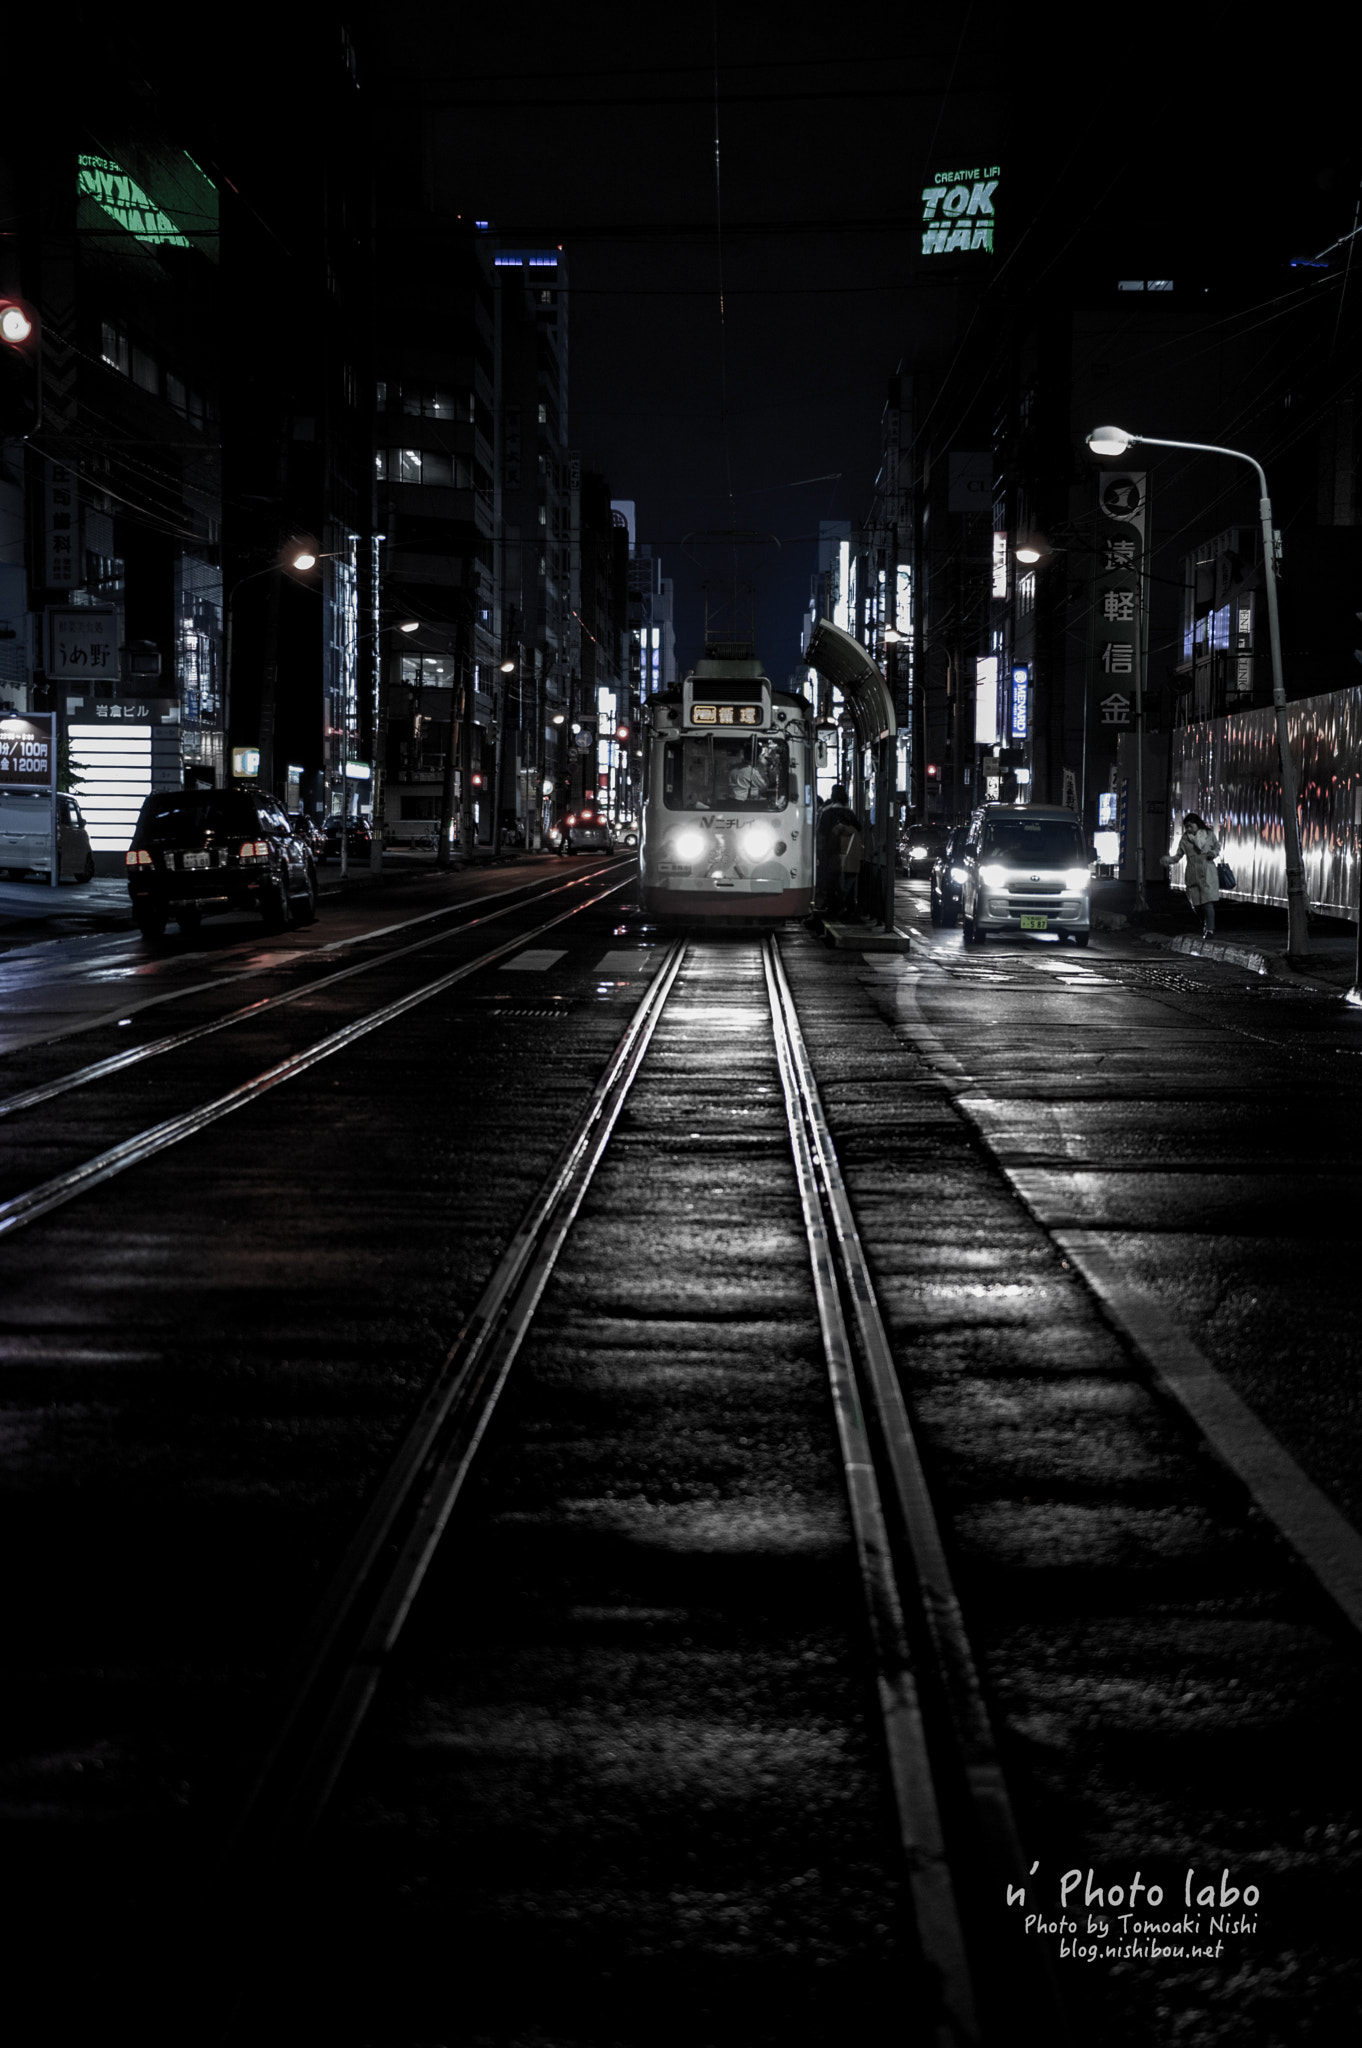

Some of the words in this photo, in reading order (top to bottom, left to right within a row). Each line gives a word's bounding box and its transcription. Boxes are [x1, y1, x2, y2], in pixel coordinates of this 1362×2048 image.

[934, 168, 981, 184] CREATIVE
[921, 180, 999, 219] TOK
[1100, 539, 1136, 725] 遠軽信金
[60, 642, 111, 668] うめ野
[95, 704, 150, 718] 岩倉ビル
[1017, 684, 1027, 731] MENARD
[13, 757, 48, 772] 1200円
